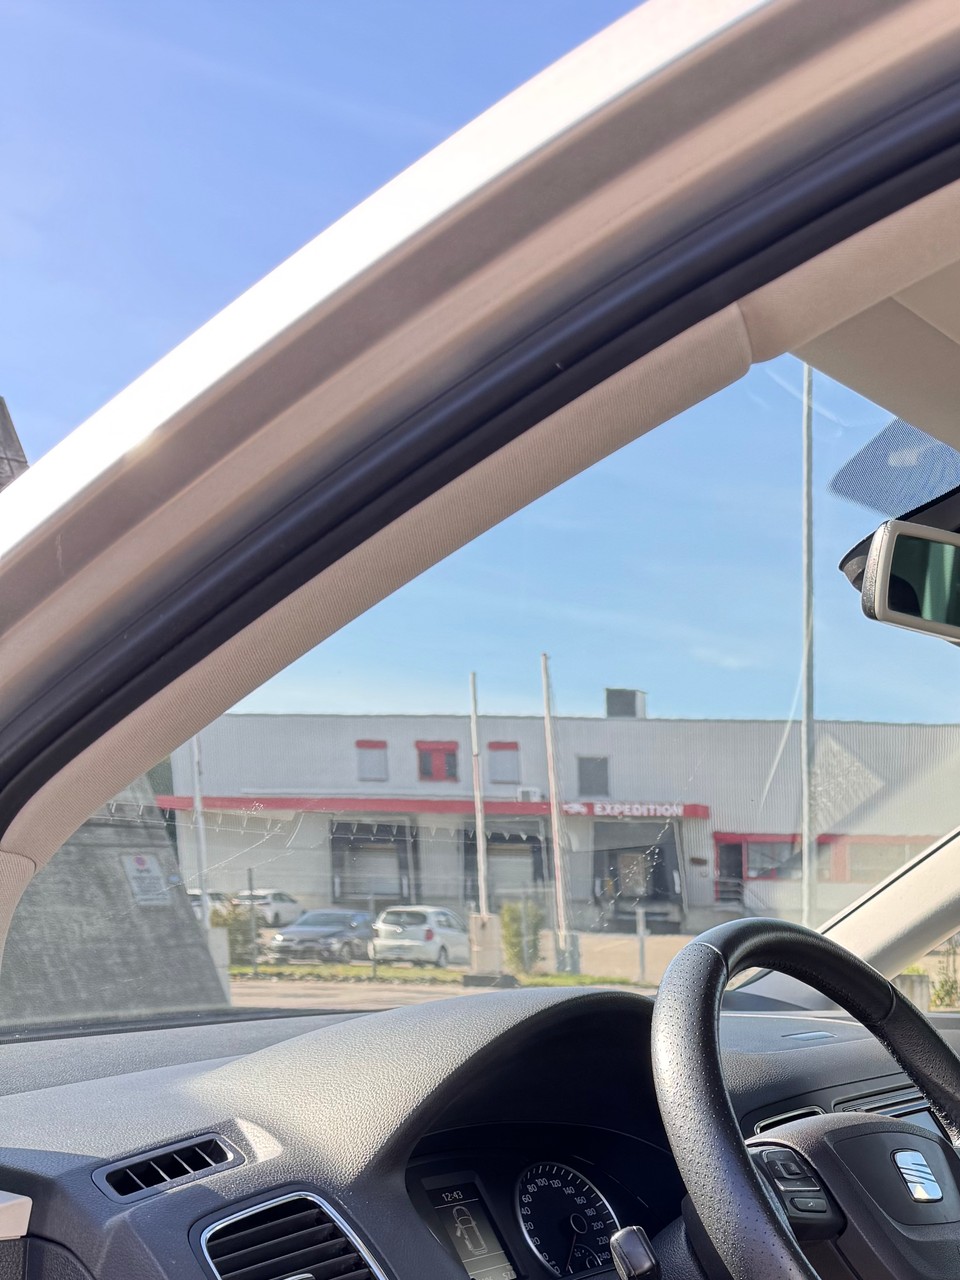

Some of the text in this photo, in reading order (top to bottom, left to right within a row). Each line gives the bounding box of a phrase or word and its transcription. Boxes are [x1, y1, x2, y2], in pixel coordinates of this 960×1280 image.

[593, 803, 684, 817] EXPEDITION
[536, 1178, 549, 1187] 100
[549, 1179, 562, 1188] 120
[526, 1183, 538, 1193] 80
[562, 1186, 576, 1195] 140
[441, 1190, 464, 1202] 12:43
[521, 1194, 533, 1203] 60
[574, 1196, 587, 1205] 160
[521, 1206, 531, 1215] 40
[584, 1207, 597, 1216] 180
[591, 1221, 605, 1230] 200
[596, 1236, 609, 1245] 220
[598, 1251, 611, 1261] 240
